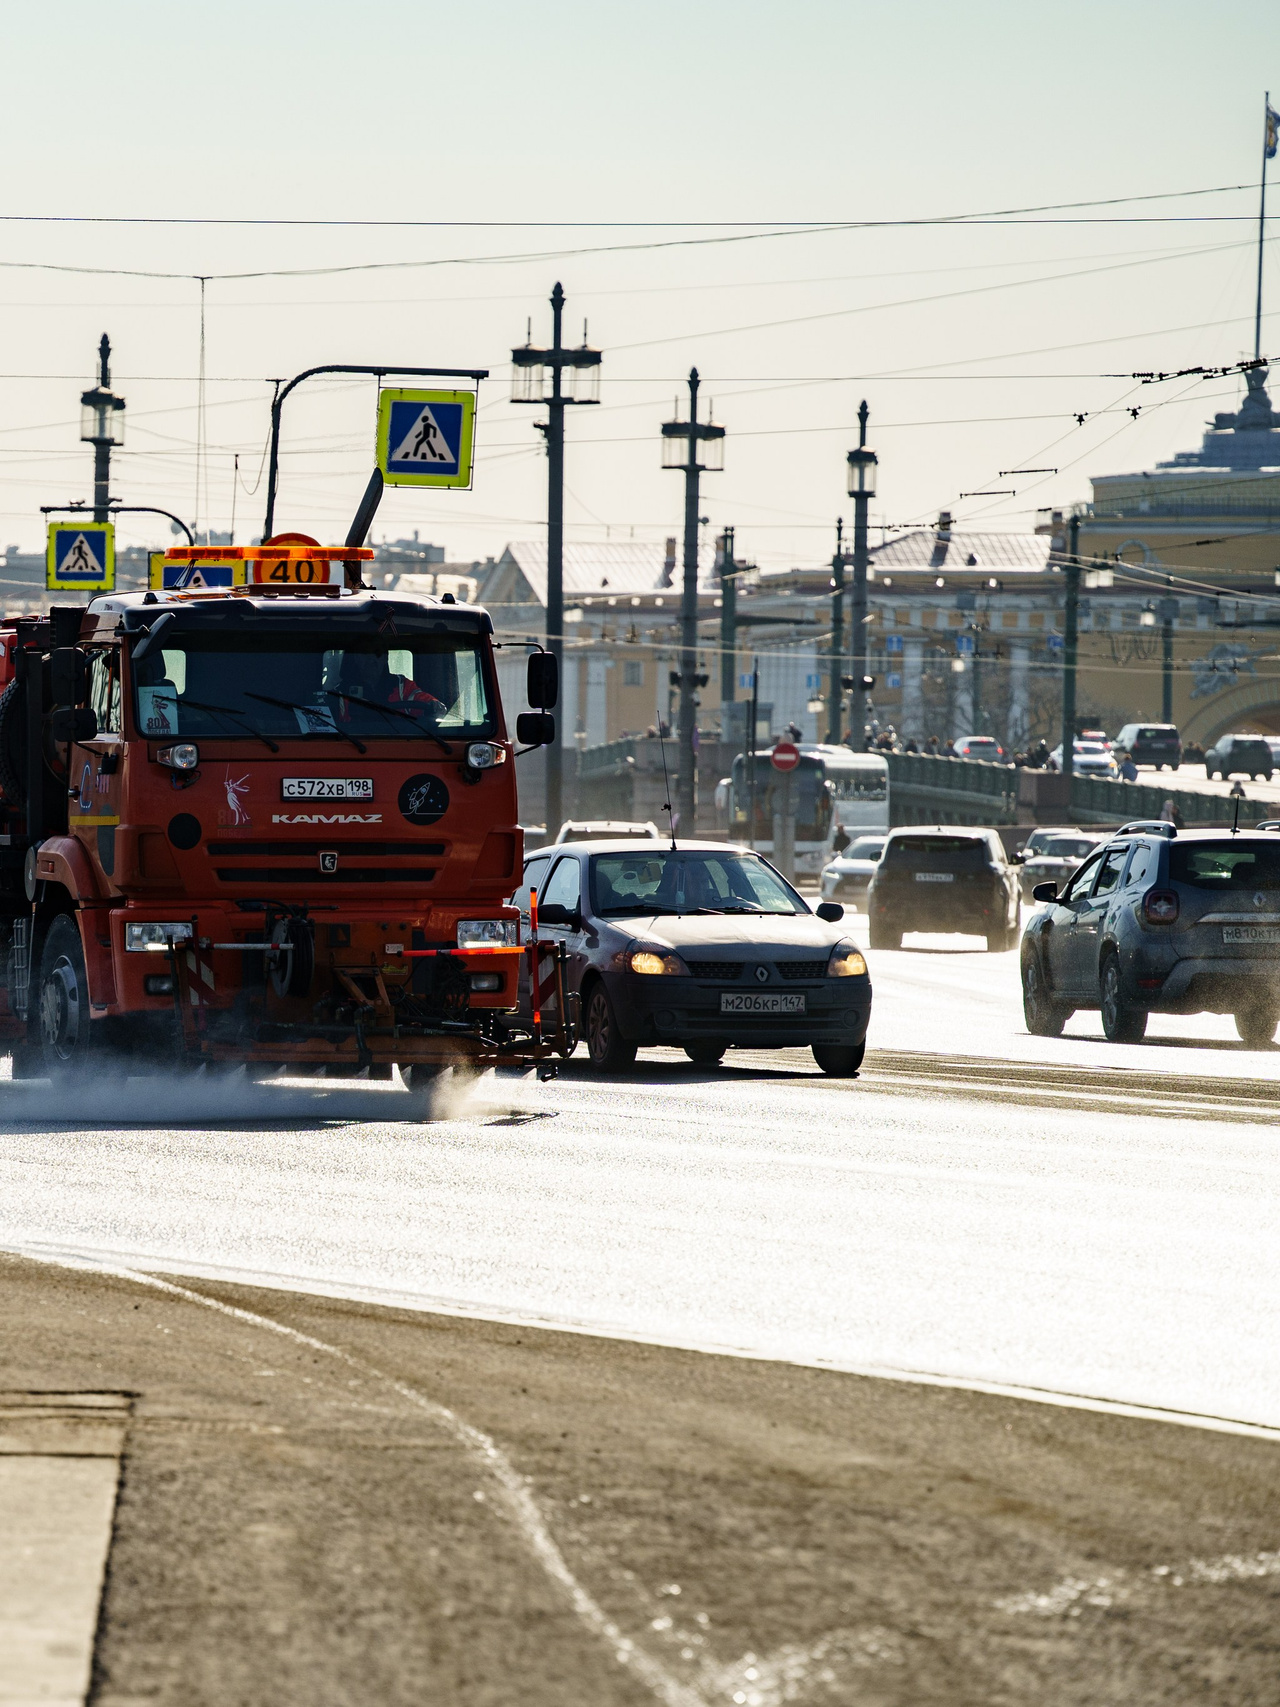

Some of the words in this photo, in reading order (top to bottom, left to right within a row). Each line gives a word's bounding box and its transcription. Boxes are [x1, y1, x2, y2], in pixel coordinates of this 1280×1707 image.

[270, 560, 314, 583] 40
[287, 781, 344, 795] С572ХВ
[347, 780, 369, 792] 198
[272, 814, 382, 823] KAMAZ
[725, 996, 779, 1010] М206КР
[782, 996, 801, 1007] 147
